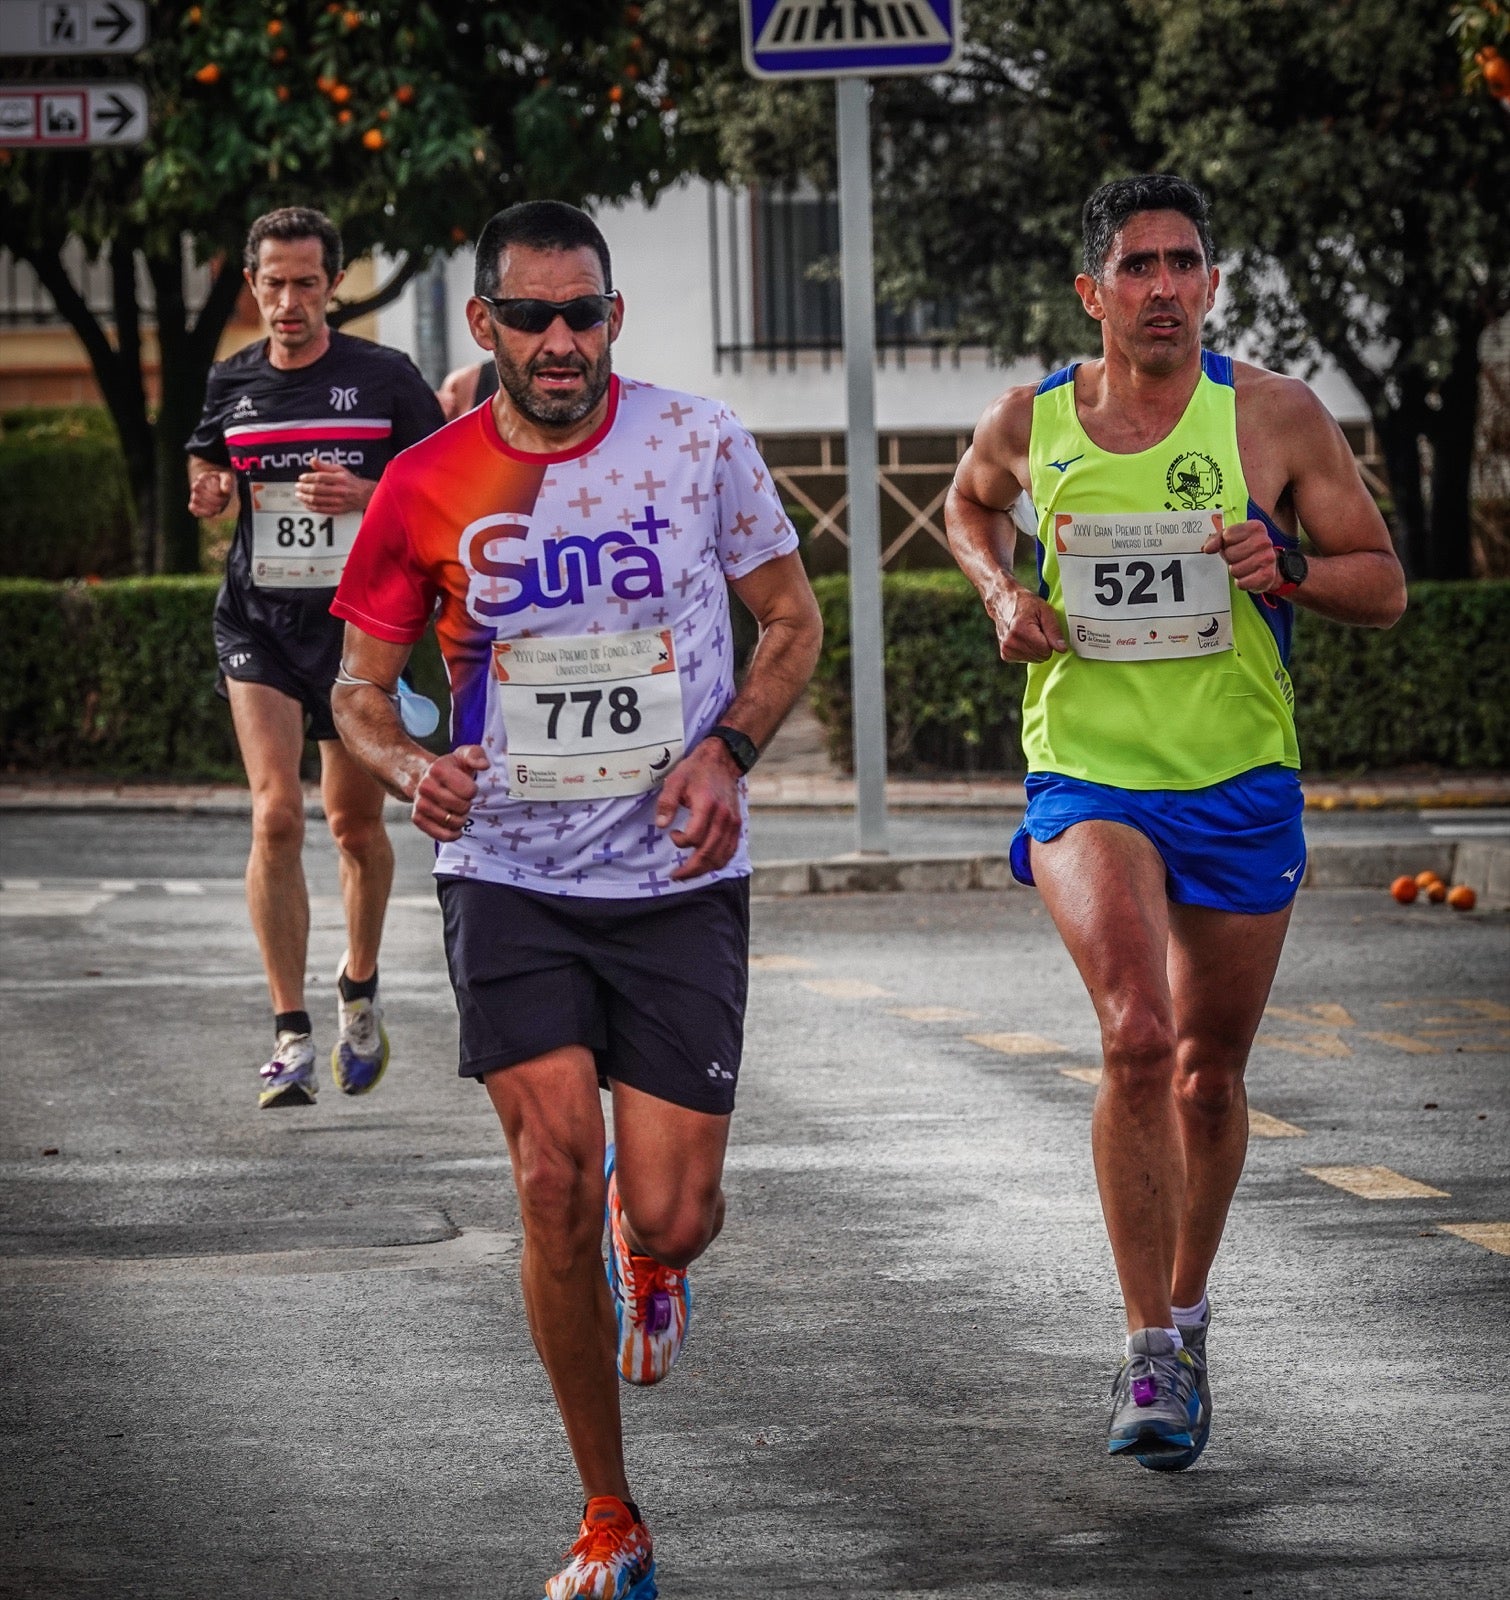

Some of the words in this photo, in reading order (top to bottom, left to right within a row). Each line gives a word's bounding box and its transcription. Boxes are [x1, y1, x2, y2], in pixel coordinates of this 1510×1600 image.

[277, 516, 334, 548] 831
[1073, 524, 1091, 537] XXXV
[1181, 520, 1203, 534] 2022
[1095, 559, 1185, 606] 521
[631, 640, 652, 656] 2022
[535, 686, 642, 740] 778
